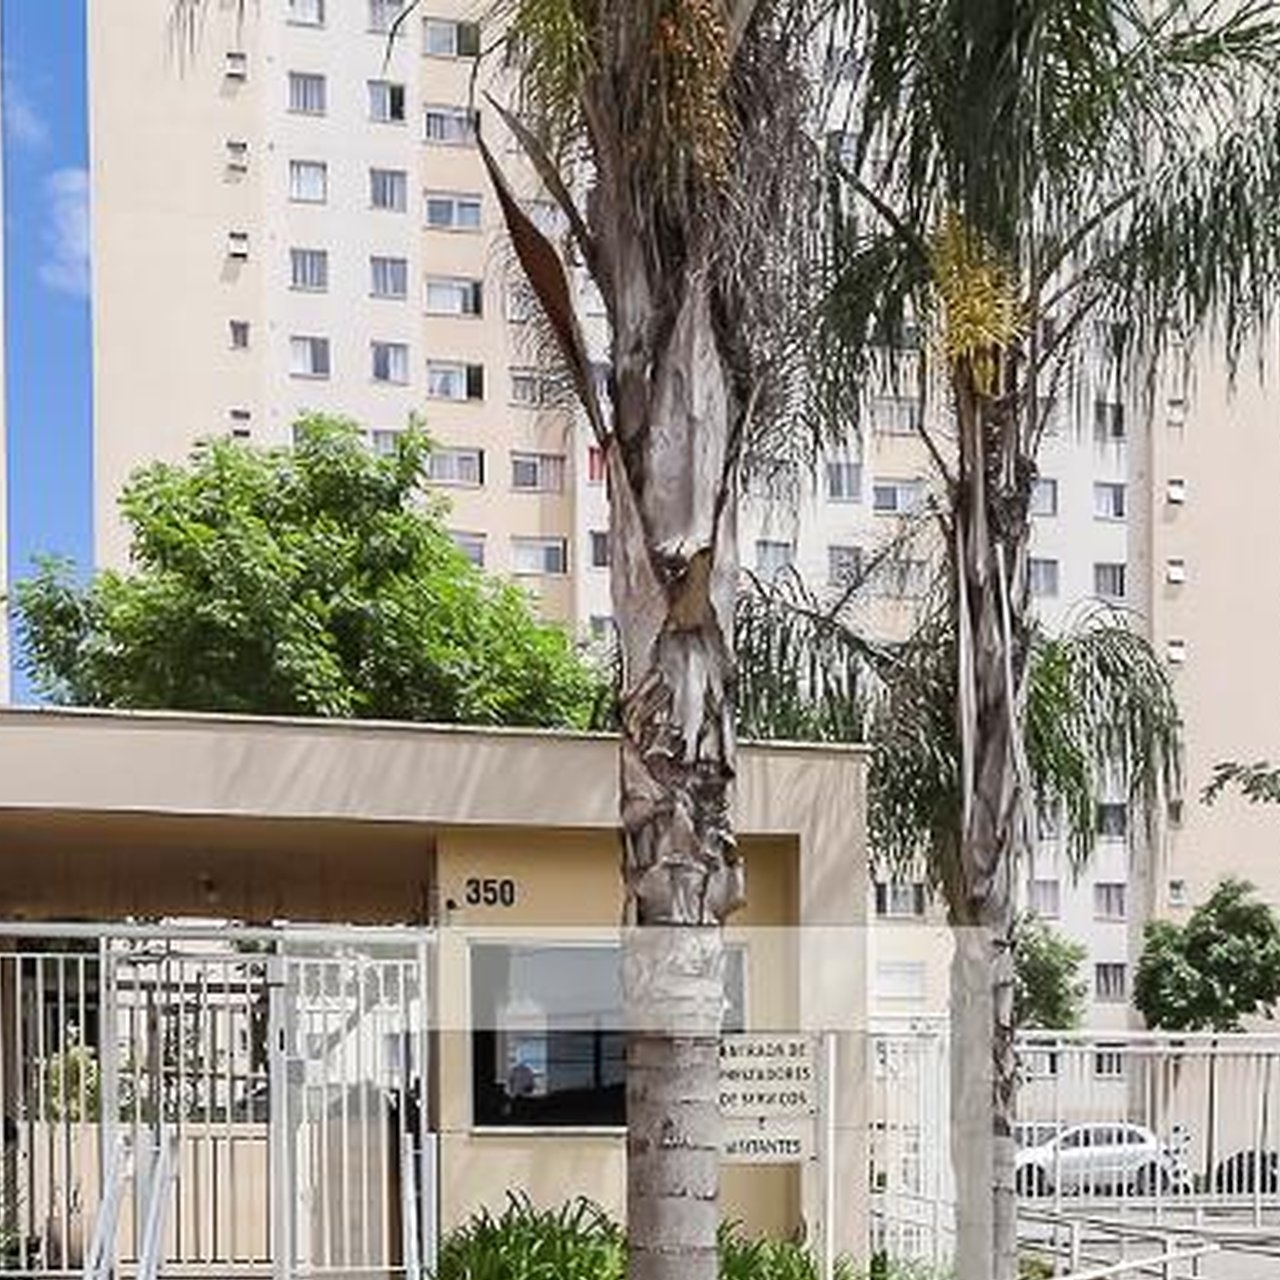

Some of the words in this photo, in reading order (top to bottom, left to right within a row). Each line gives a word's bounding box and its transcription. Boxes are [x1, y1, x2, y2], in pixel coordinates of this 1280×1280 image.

[466, 878, 514, 907] 350
[789, 1043, 806, 1057] DE
[723, 1139, 801, 1154] VISITANTES
